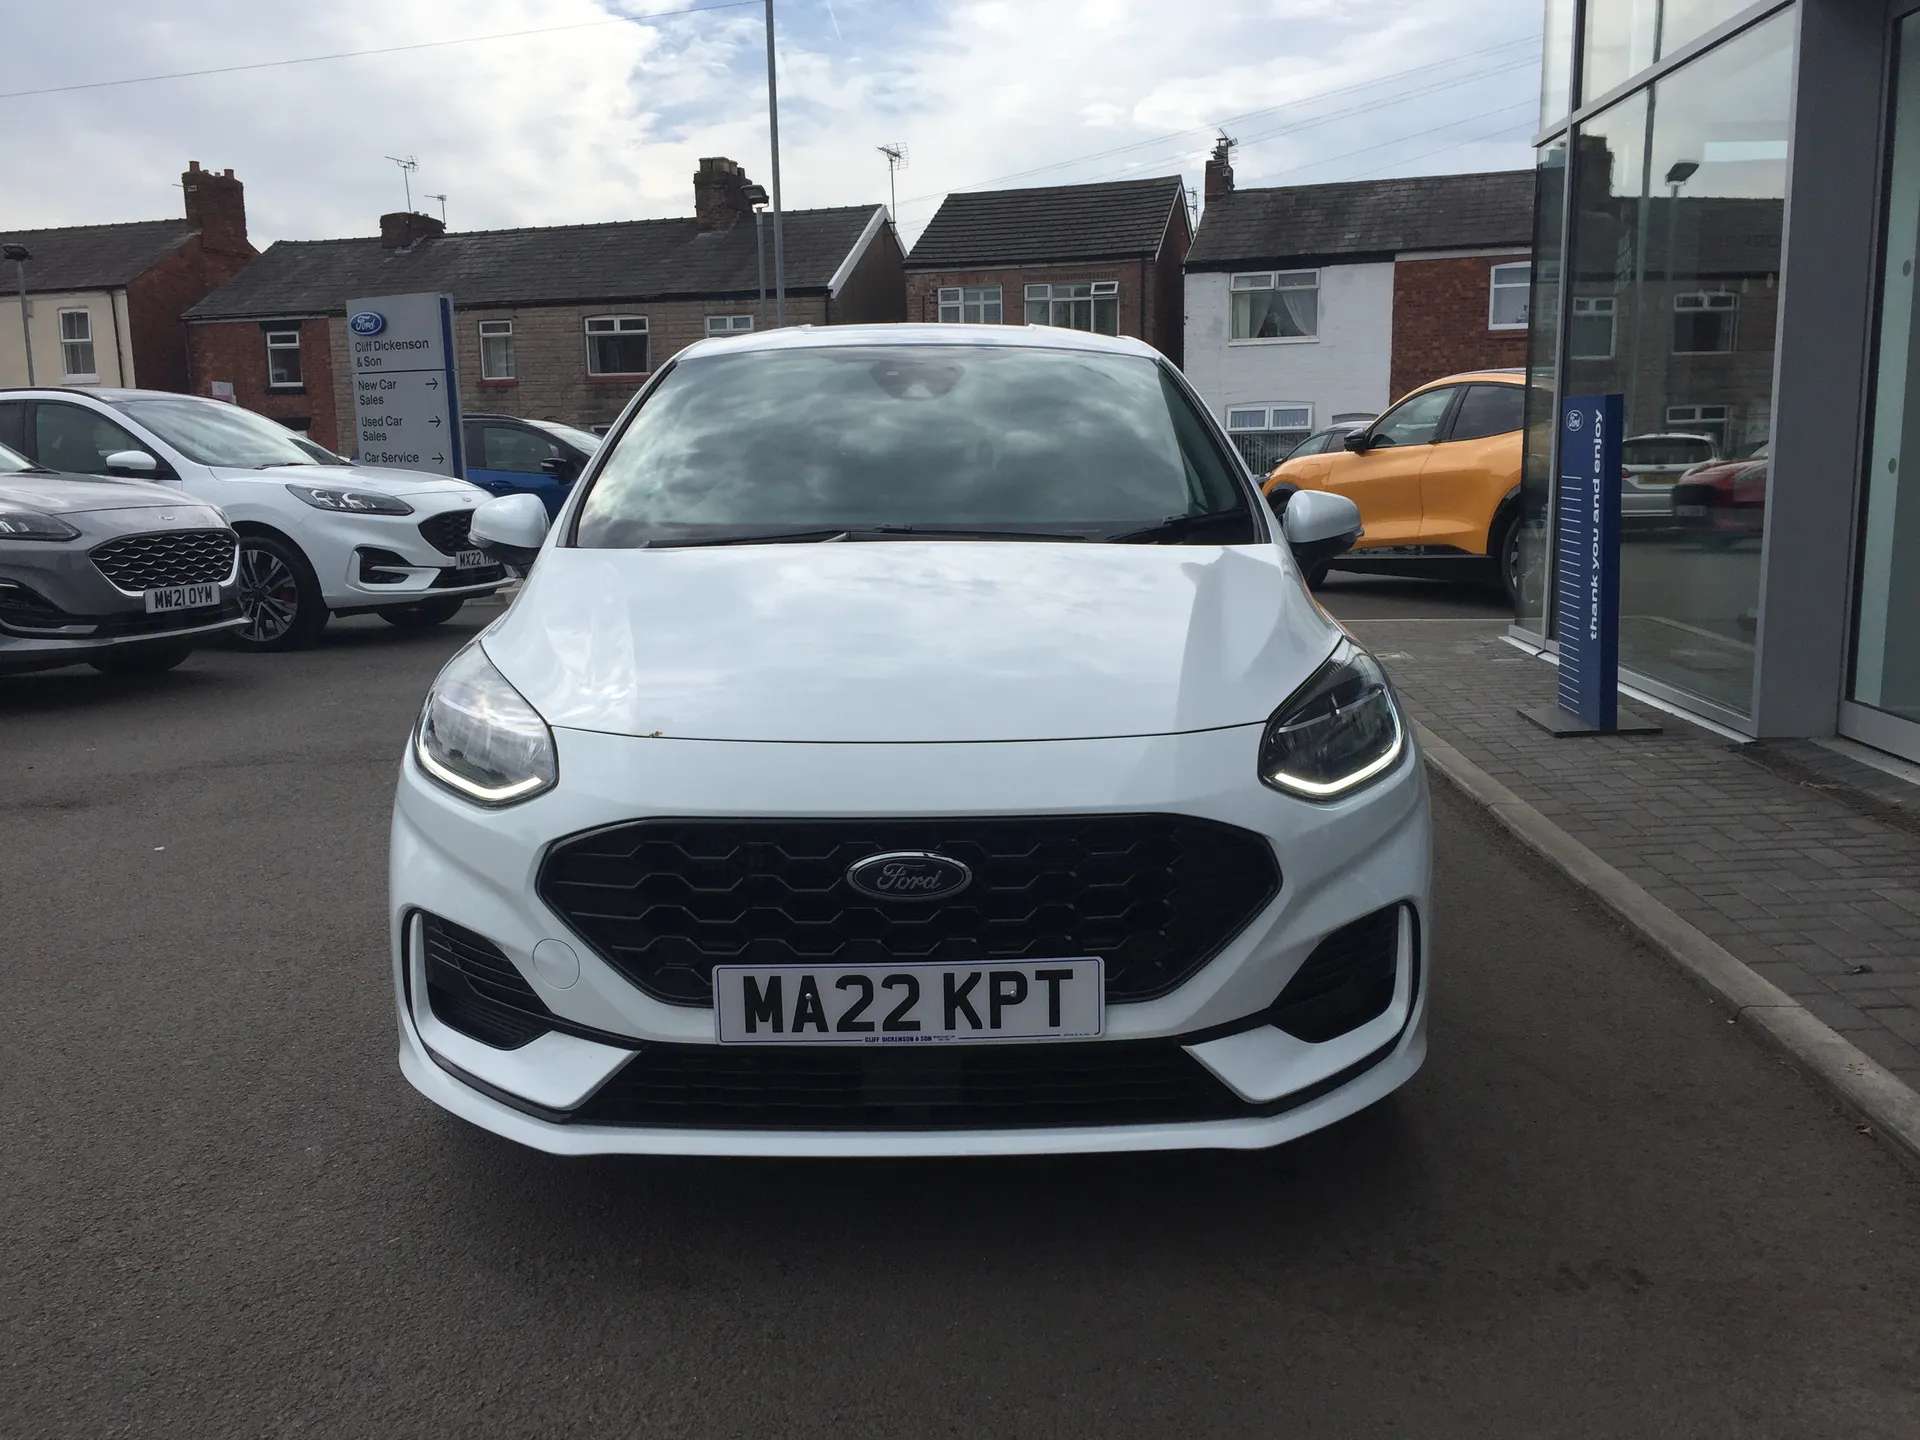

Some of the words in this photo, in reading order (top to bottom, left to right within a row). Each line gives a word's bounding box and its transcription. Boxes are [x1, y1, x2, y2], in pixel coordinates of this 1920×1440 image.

[354, 341, 372, 353] Cliff
[374, 340, 430, 352] Dickenson
[364, 356, 382, 367] Son
[358, 381, 377, 391] New
[379, 379, 397, 390] Car
[360, 394, 385, 406] Sales
[361, 416, 384, 427] Used
[385, 415, 403, 426] Car
[363, 430, 388, 441] Sales
[1593, 409, 1603, 474] enjoy
[364, 452, 379, 463] Car
[381, 451, 420, 463] Service
[1592, 479, 1601, 523] and
[1592, 528, 1600, 570] you
[459, 552, 481, 567] MX22
[154, 589, 186, 609] MW21
[188, 585, 213, 604] OYM
[1590, 574, 1599, 641] thank
[876, 863, 943, 890] Ford
[743, 974, 921, 1034] MA22
[943, 969, 1074, 1031] KPT
